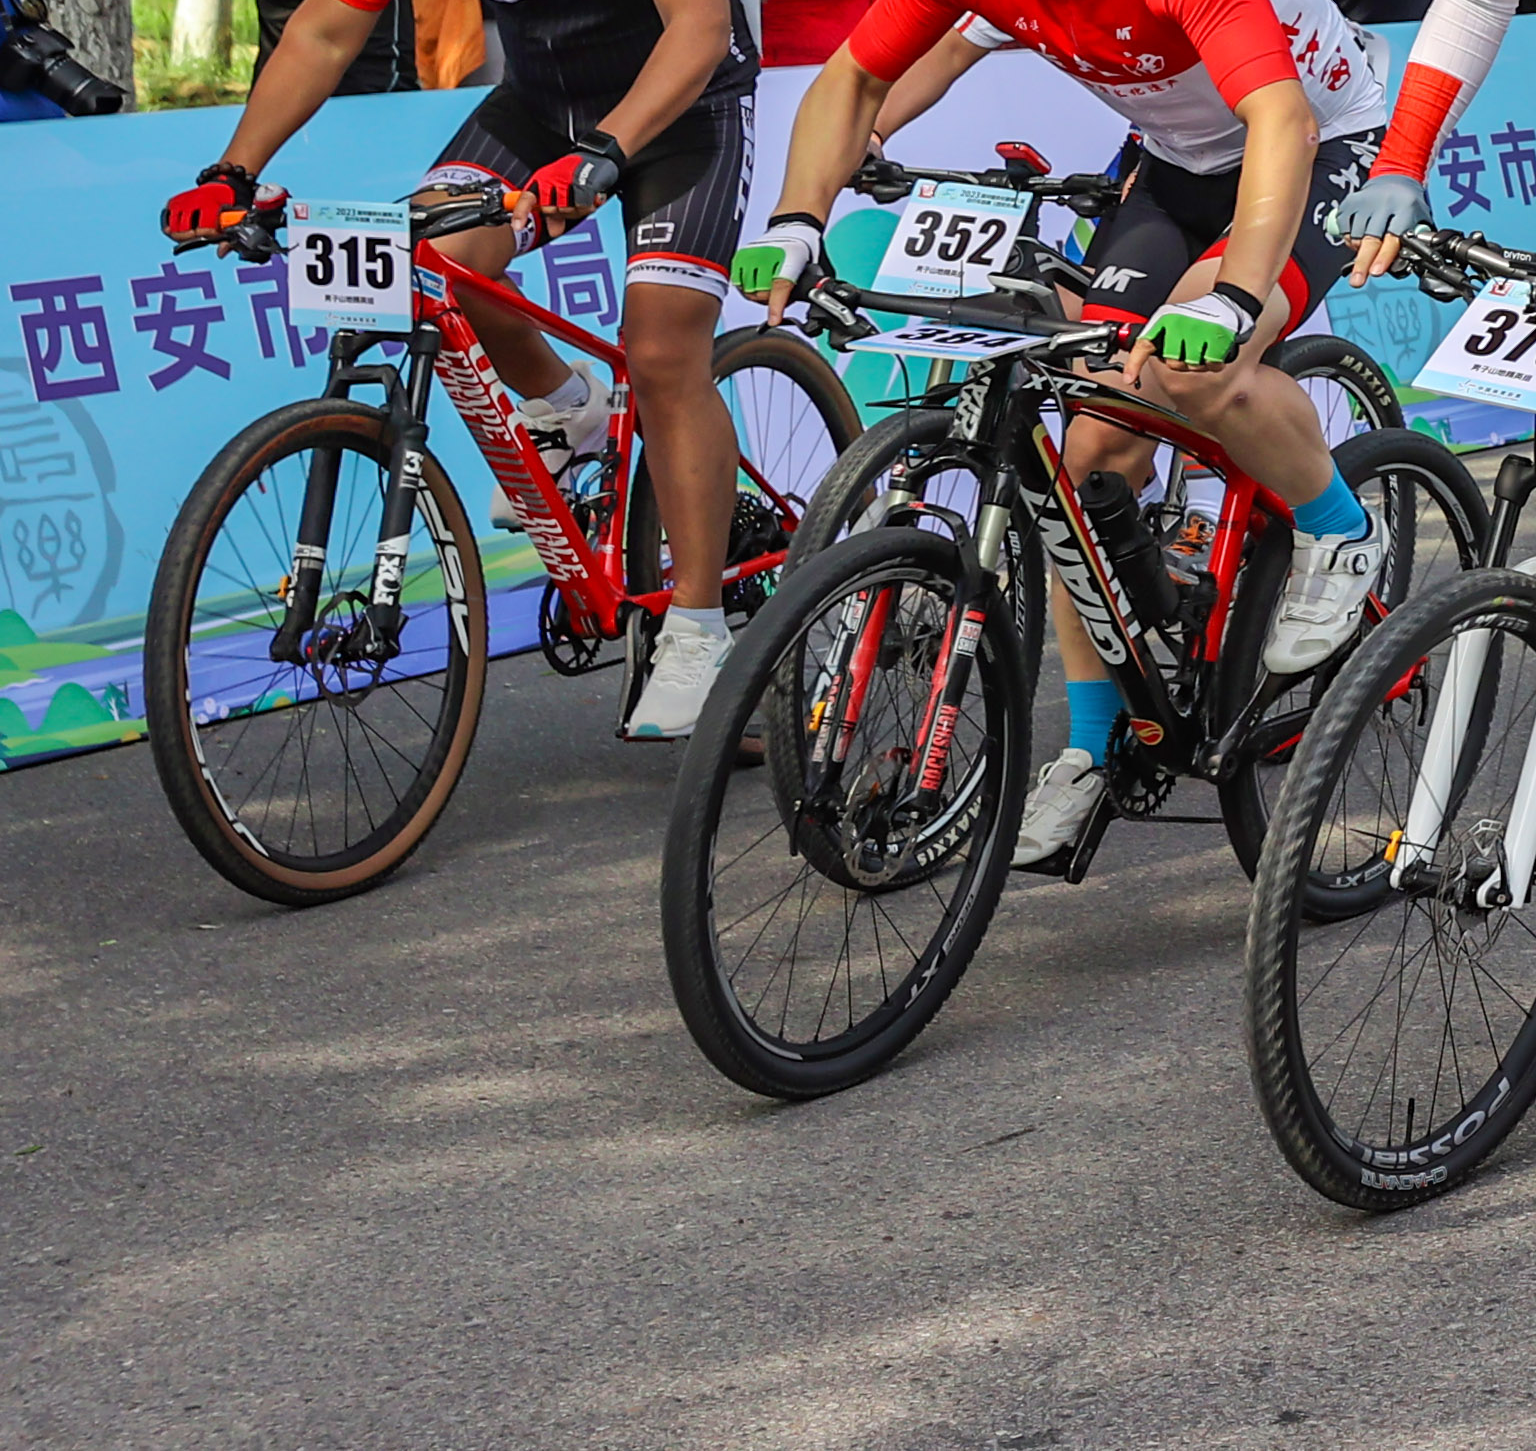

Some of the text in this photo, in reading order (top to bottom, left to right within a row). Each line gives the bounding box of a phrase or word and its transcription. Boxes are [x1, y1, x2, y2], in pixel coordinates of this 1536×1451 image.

[305, 232, 395, 290] 315
[904, 210, 1008, 267] 352
[1021, 372, 1099, 398] XTC
[1340, 354, 1391, 407] MAXXIS
[916, 795, 982, 868] MAXXIS
